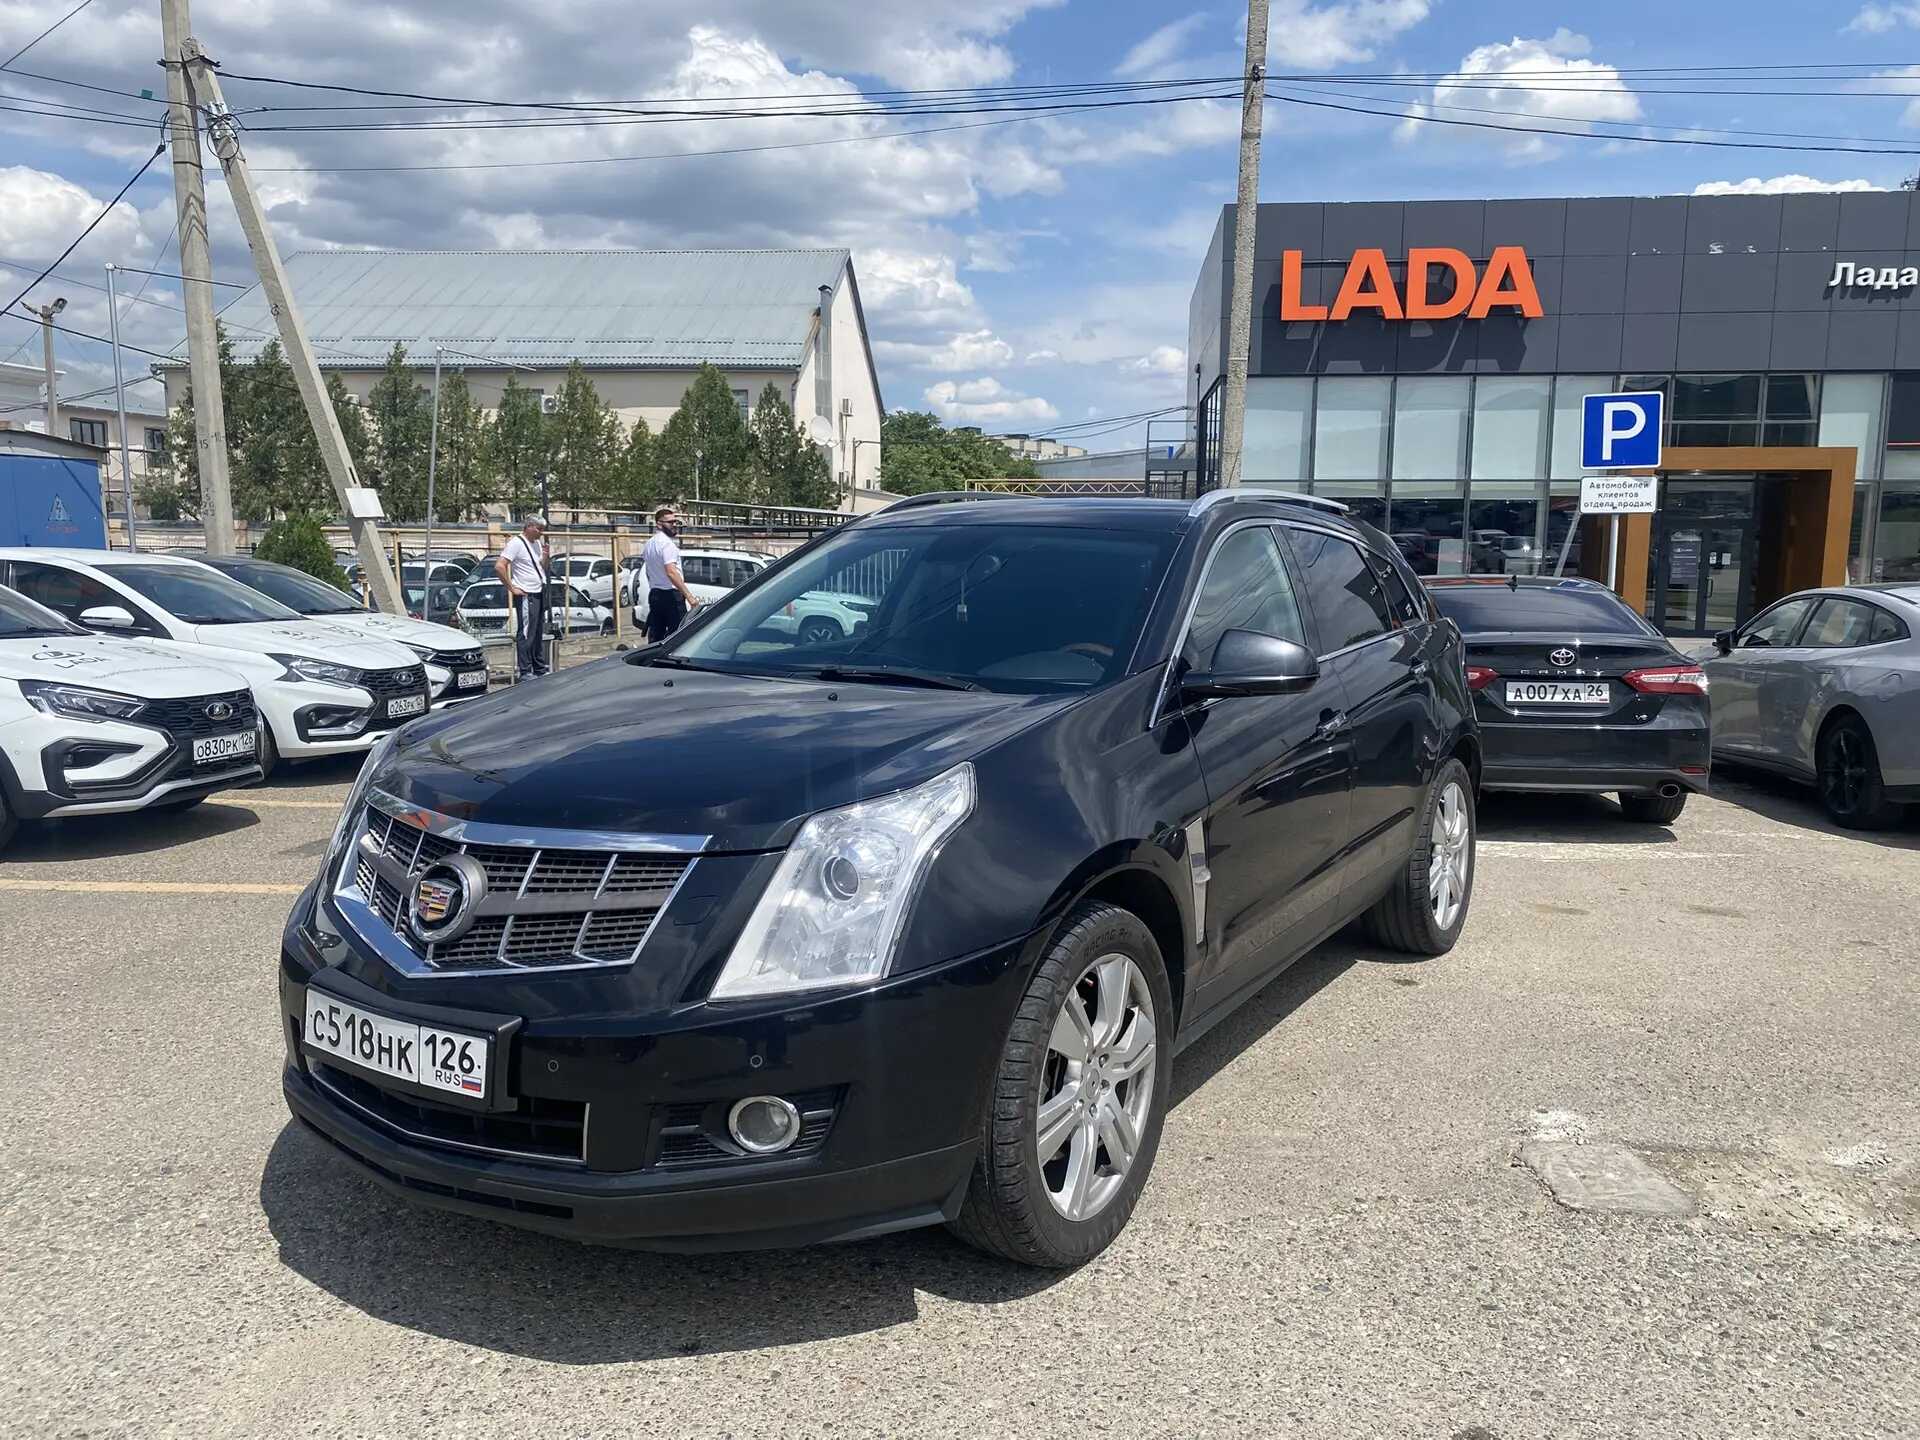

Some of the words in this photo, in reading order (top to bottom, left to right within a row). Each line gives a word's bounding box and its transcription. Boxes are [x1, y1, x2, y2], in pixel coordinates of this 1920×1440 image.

[1281, 246, 1544, 320] LADA
[1828, 262, 1918, 290] Лада
[1602, 402, 1646, 460] P
[1589, 481, 1649, 489] Автомобилей
[1587, 684, 1603, 697] 26
[240, 733, 254, 746] 126
[312, 1004, 414, 1075] С518НК
[424, 1033, 475, 1074] 126
[435, 1069, 461, 1086] RUS
